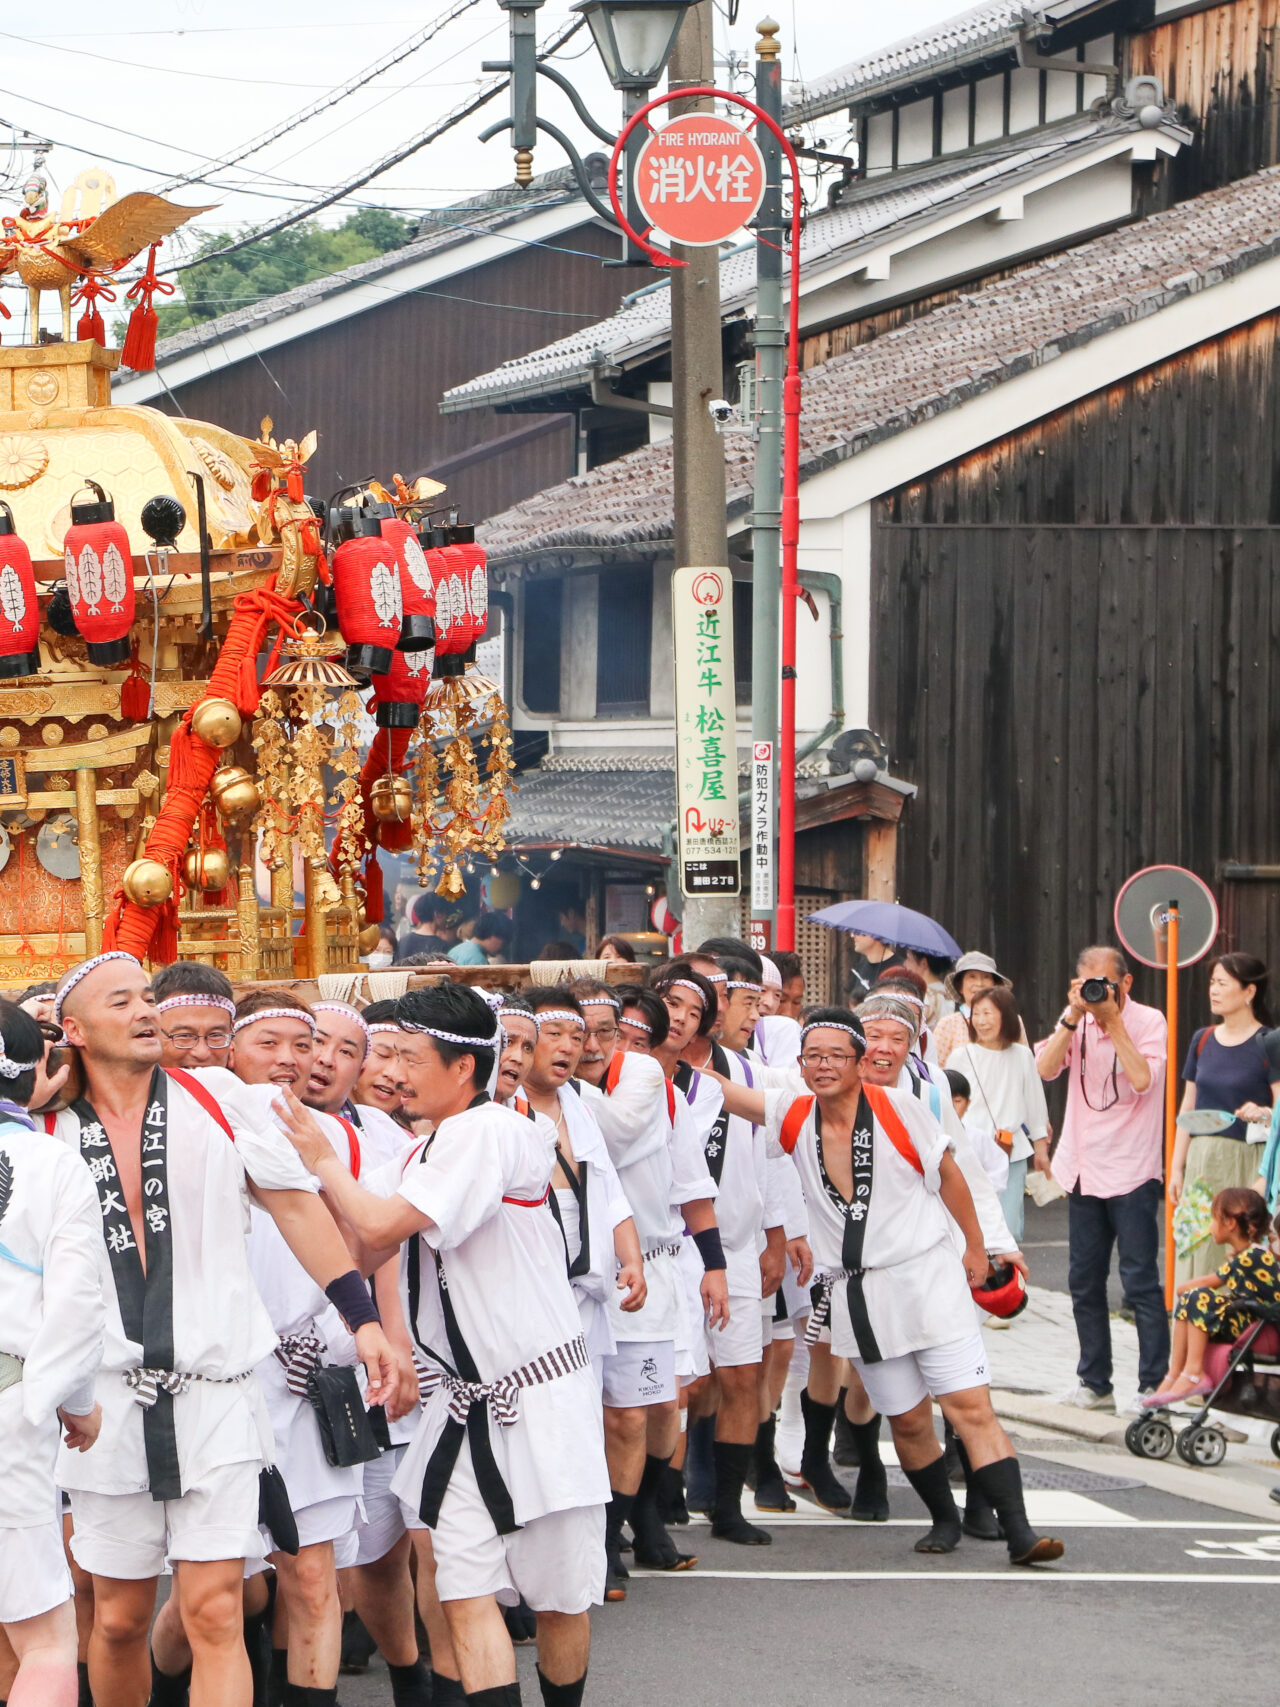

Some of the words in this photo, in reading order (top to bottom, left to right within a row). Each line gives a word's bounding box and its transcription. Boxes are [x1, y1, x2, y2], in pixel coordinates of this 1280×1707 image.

[649, 154, 754, 204] 消火栓
[658, 132, 684, 146] FIRE
[688, 132, 742, 146] HYDRANT
[696, 612, 723, 698] 近江牛
[694, 704, 727, 801] 松喜屋
[708, 818, 737, 832] Uターン
[756, 764, 768, 868] 防犯カメラ作動中
[686, 863, 708, 871] ここは
[80, 1121, 137, 1254] 建部大社
[142, 1100, 169, 1234] 近江一の宮
[850, 1127, 873, 1222] 近江一の宮
